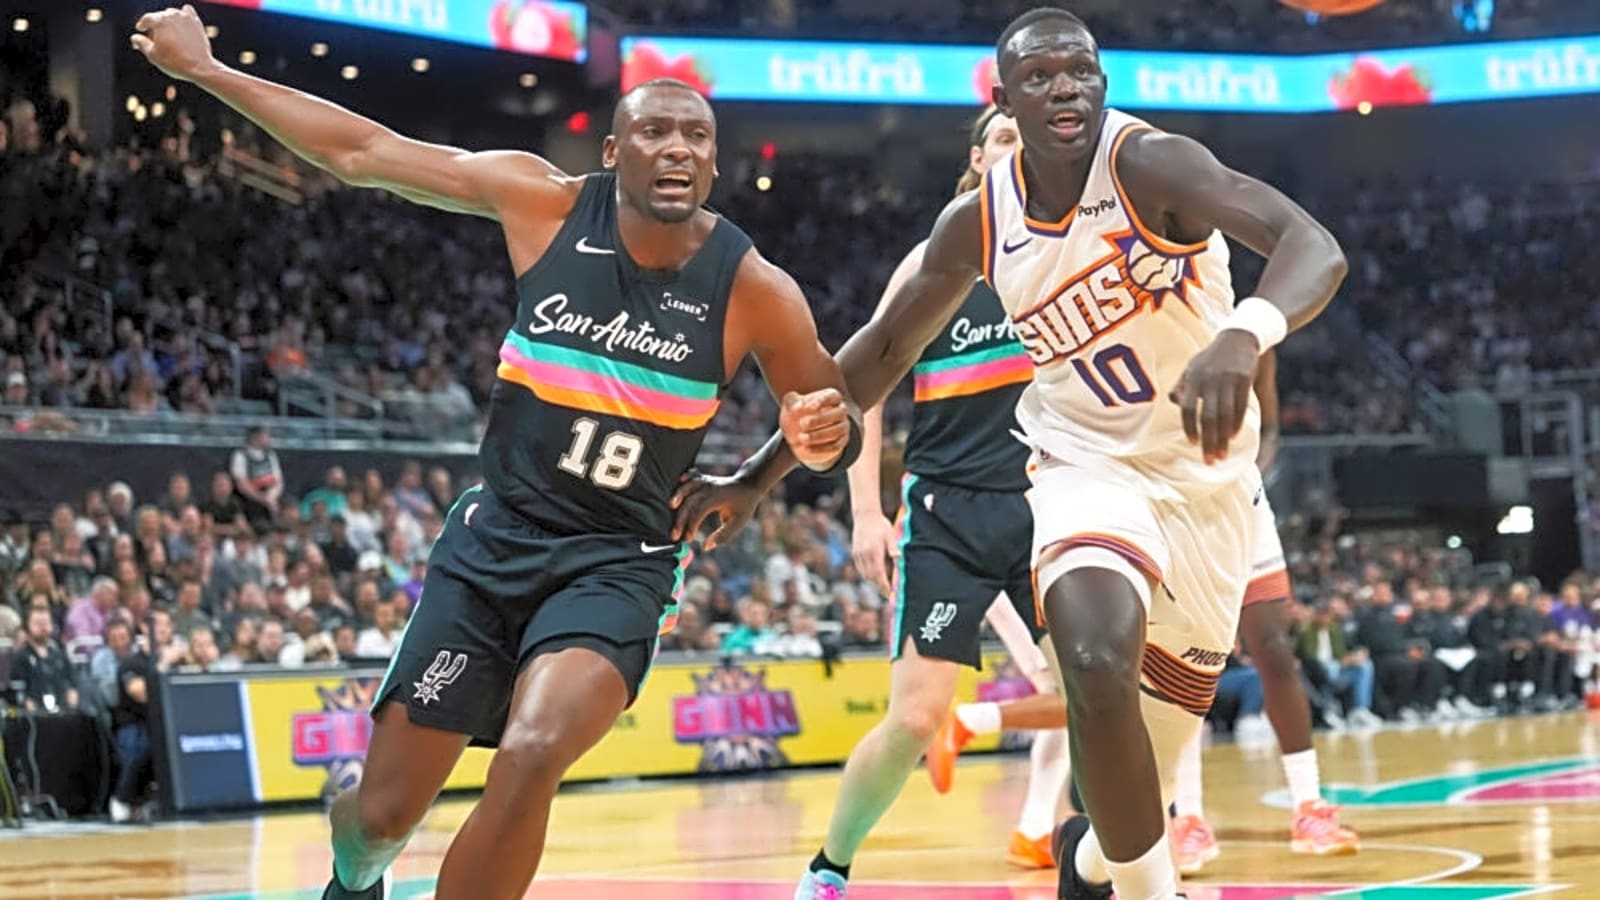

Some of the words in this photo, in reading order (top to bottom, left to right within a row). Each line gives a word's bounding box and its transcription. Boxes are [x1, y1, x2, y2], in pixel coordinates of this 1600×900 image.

[1486, 44, 1600, 91] trüfr
[529, 293, 593, 334] San
[591, 310, 693, 362] Antonio
[951, 317, 993, 352] San
[1013, 263, 1137, 365] SUNS
[1070, 343, 1158, 407] 10
[557, 416, 645, 491] 18
[1181, 646, 1227, 667] PHOE
